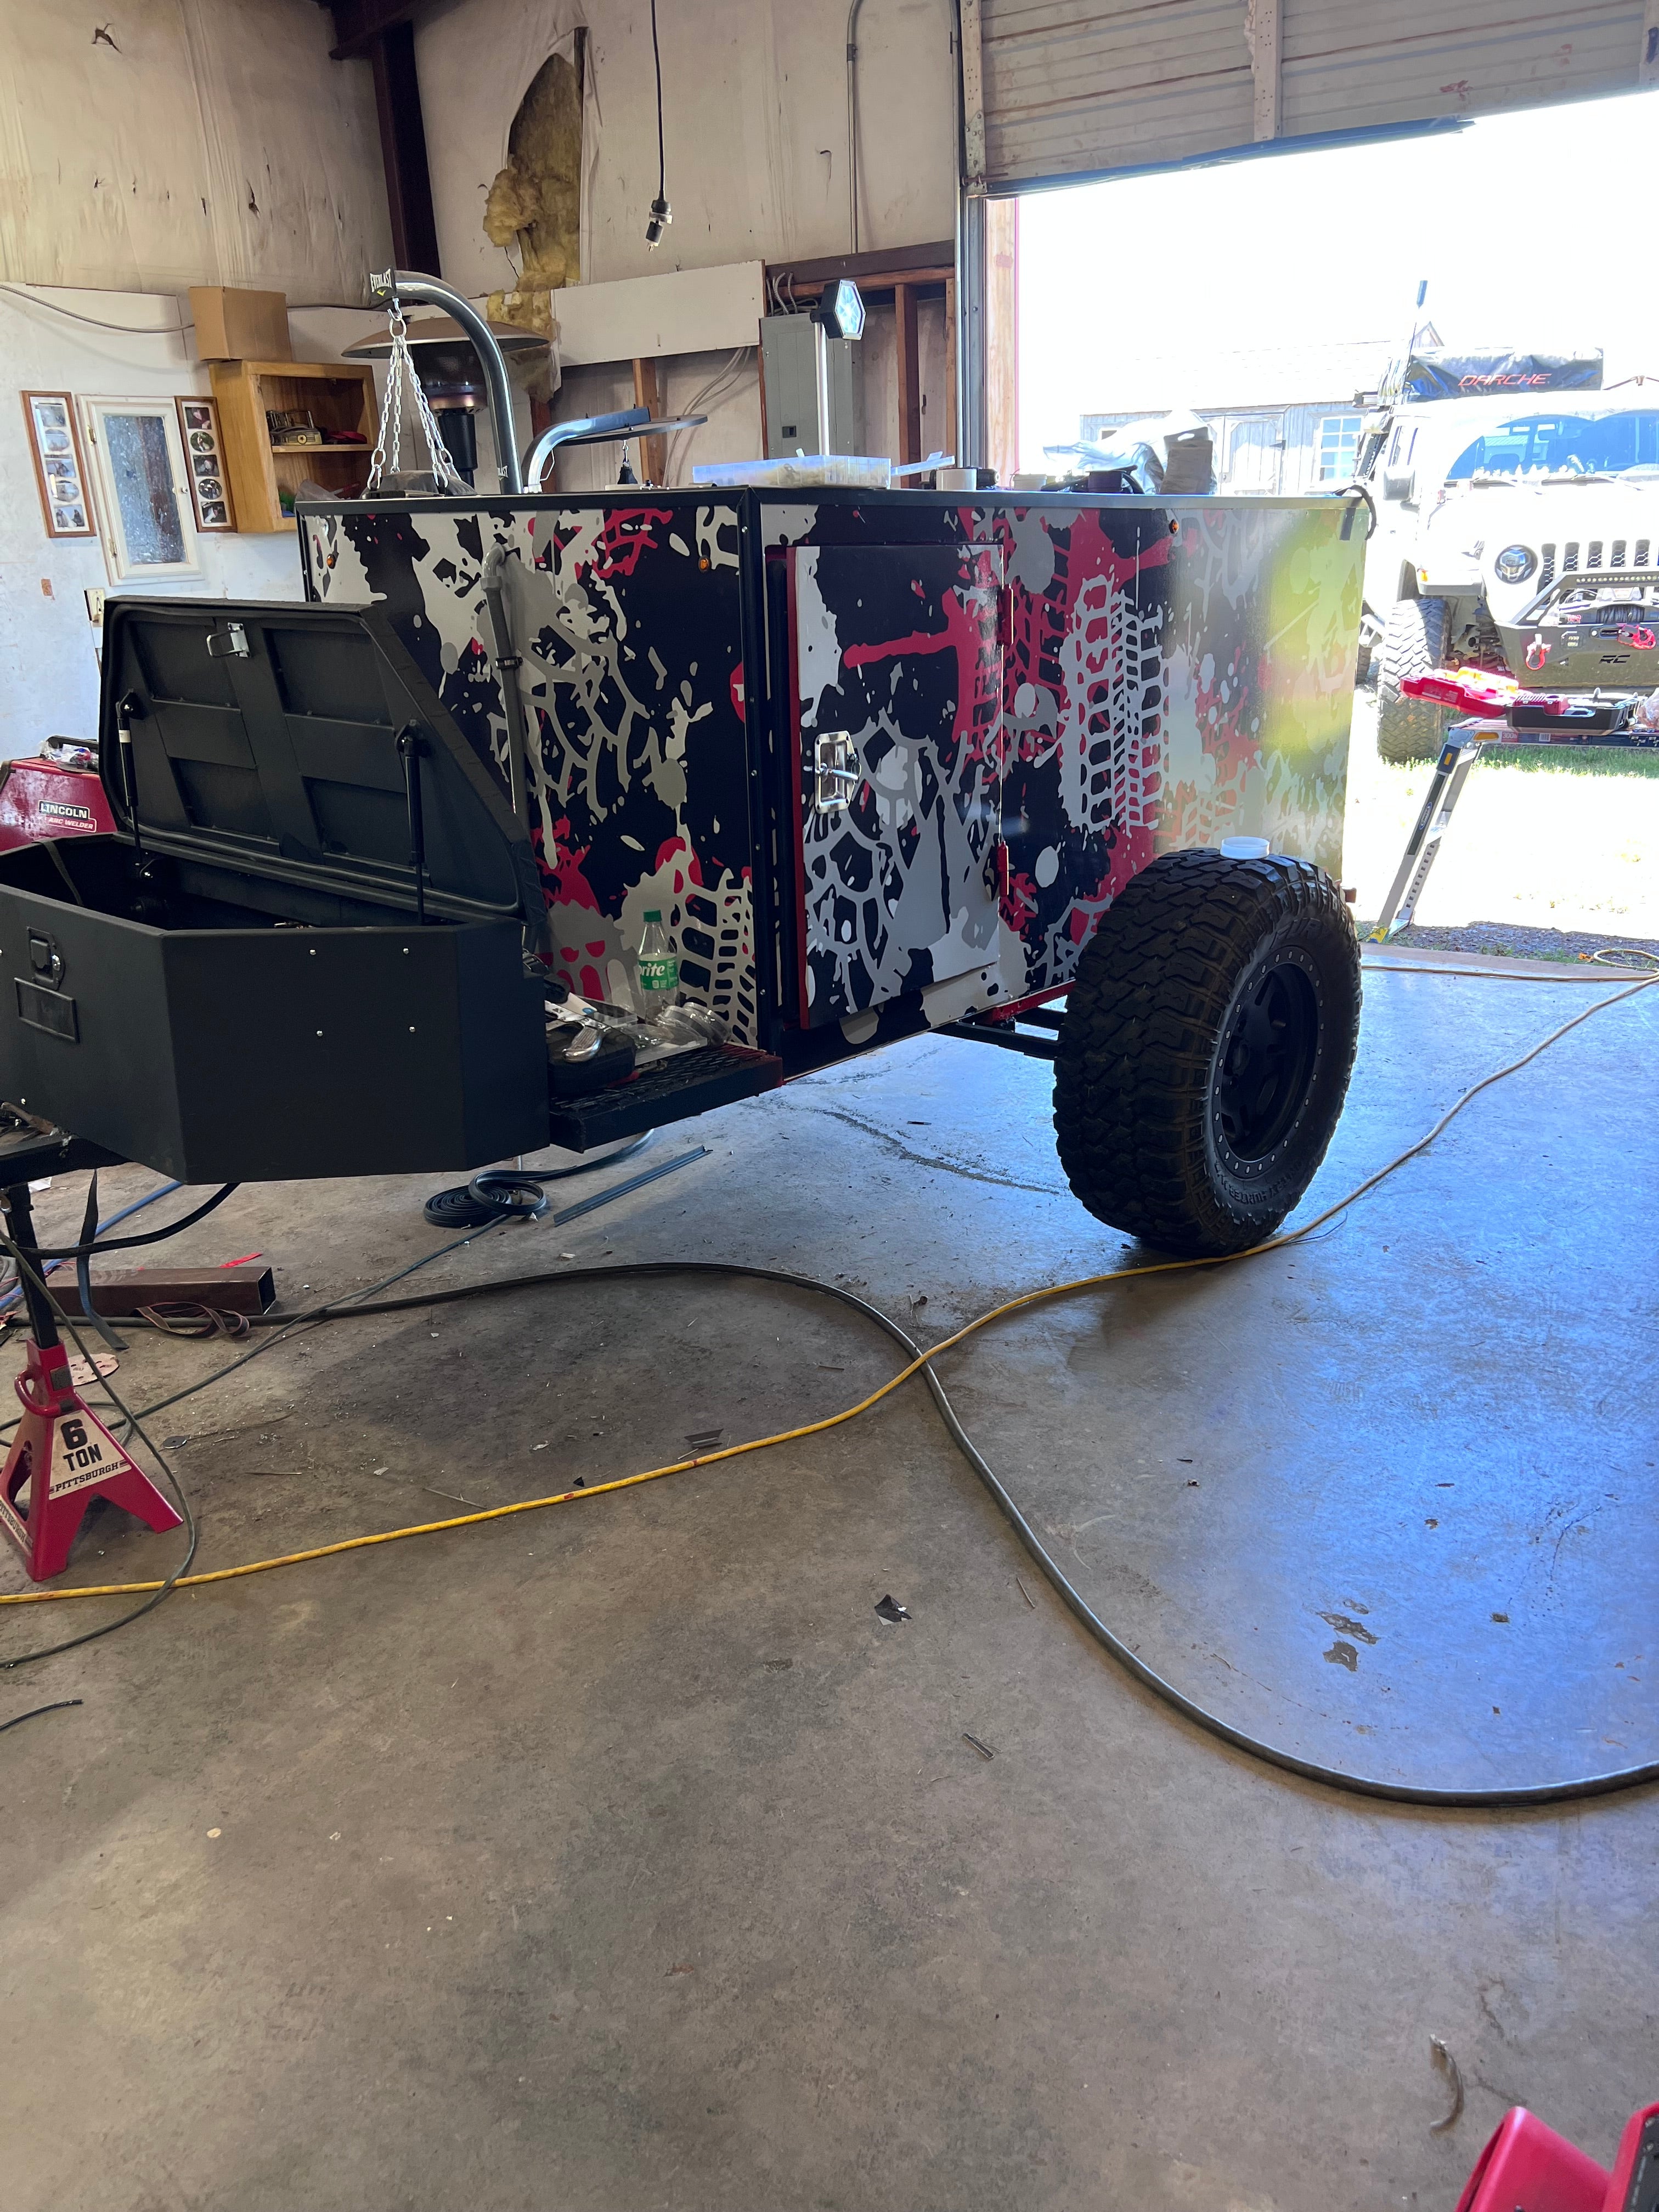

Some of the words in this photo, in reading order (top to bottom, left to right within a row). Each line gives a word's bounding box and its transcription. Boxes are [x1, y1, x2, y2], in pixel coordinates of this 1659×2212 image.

[369, 268, 393, 292] EVERLAST
[1458, 373, 1552, 386] DARCHE
[1599, 654, 1630, 664] RC
[41, 803, 87, 819] LINCOLN
[48, 816, 64, 825] ARC
[65, 819, 93, 830] WELDER
[60, 1418, 88, 1450] 6
[63, 1443, 103, 1471] TON
[55, 1462, 119, 1492] PITTSBURGH
